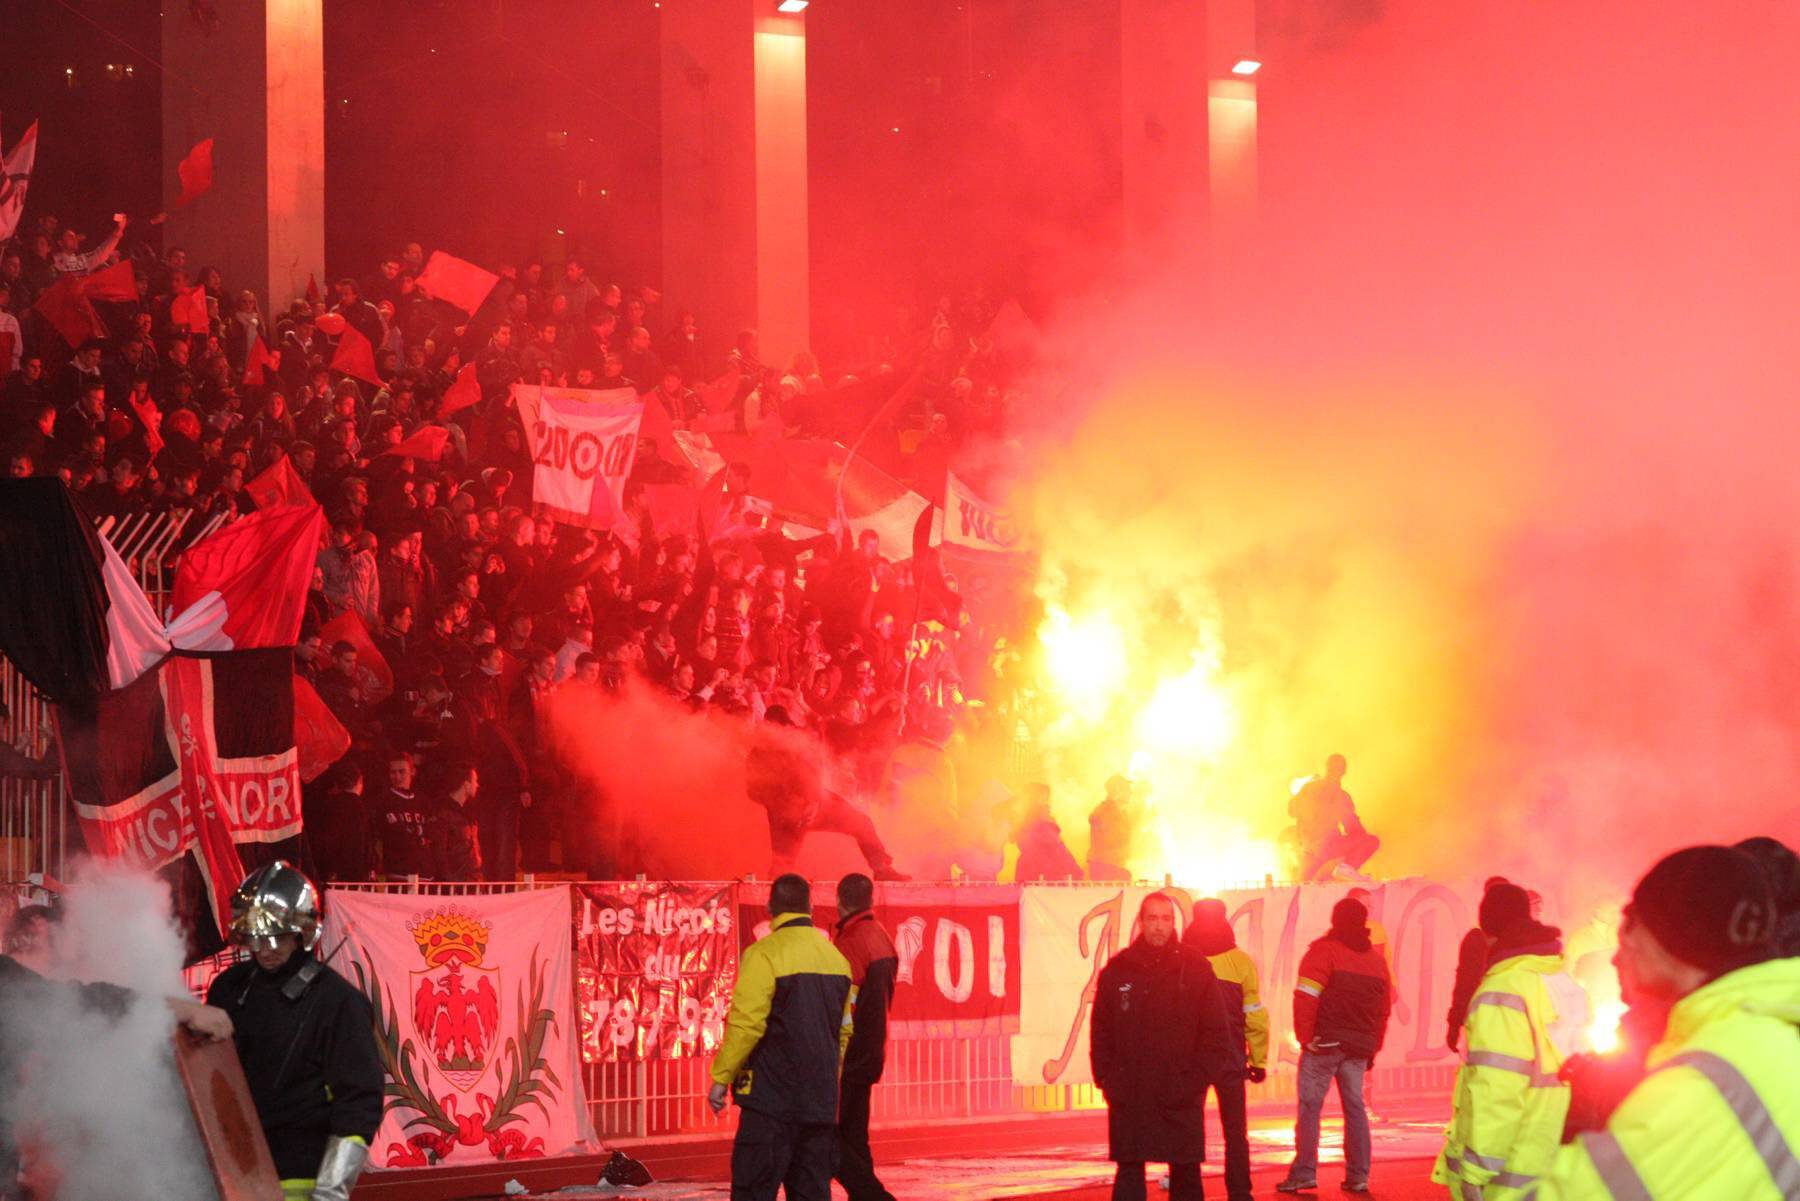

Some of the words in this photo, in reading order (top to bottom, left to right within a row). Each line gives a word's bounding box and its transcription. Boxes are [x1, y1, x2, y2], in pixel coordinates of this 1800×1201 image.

[213, 768, 301, 826] NOR
[582, 898, 635, 935] Les
[644, 946, 681, 981] du
